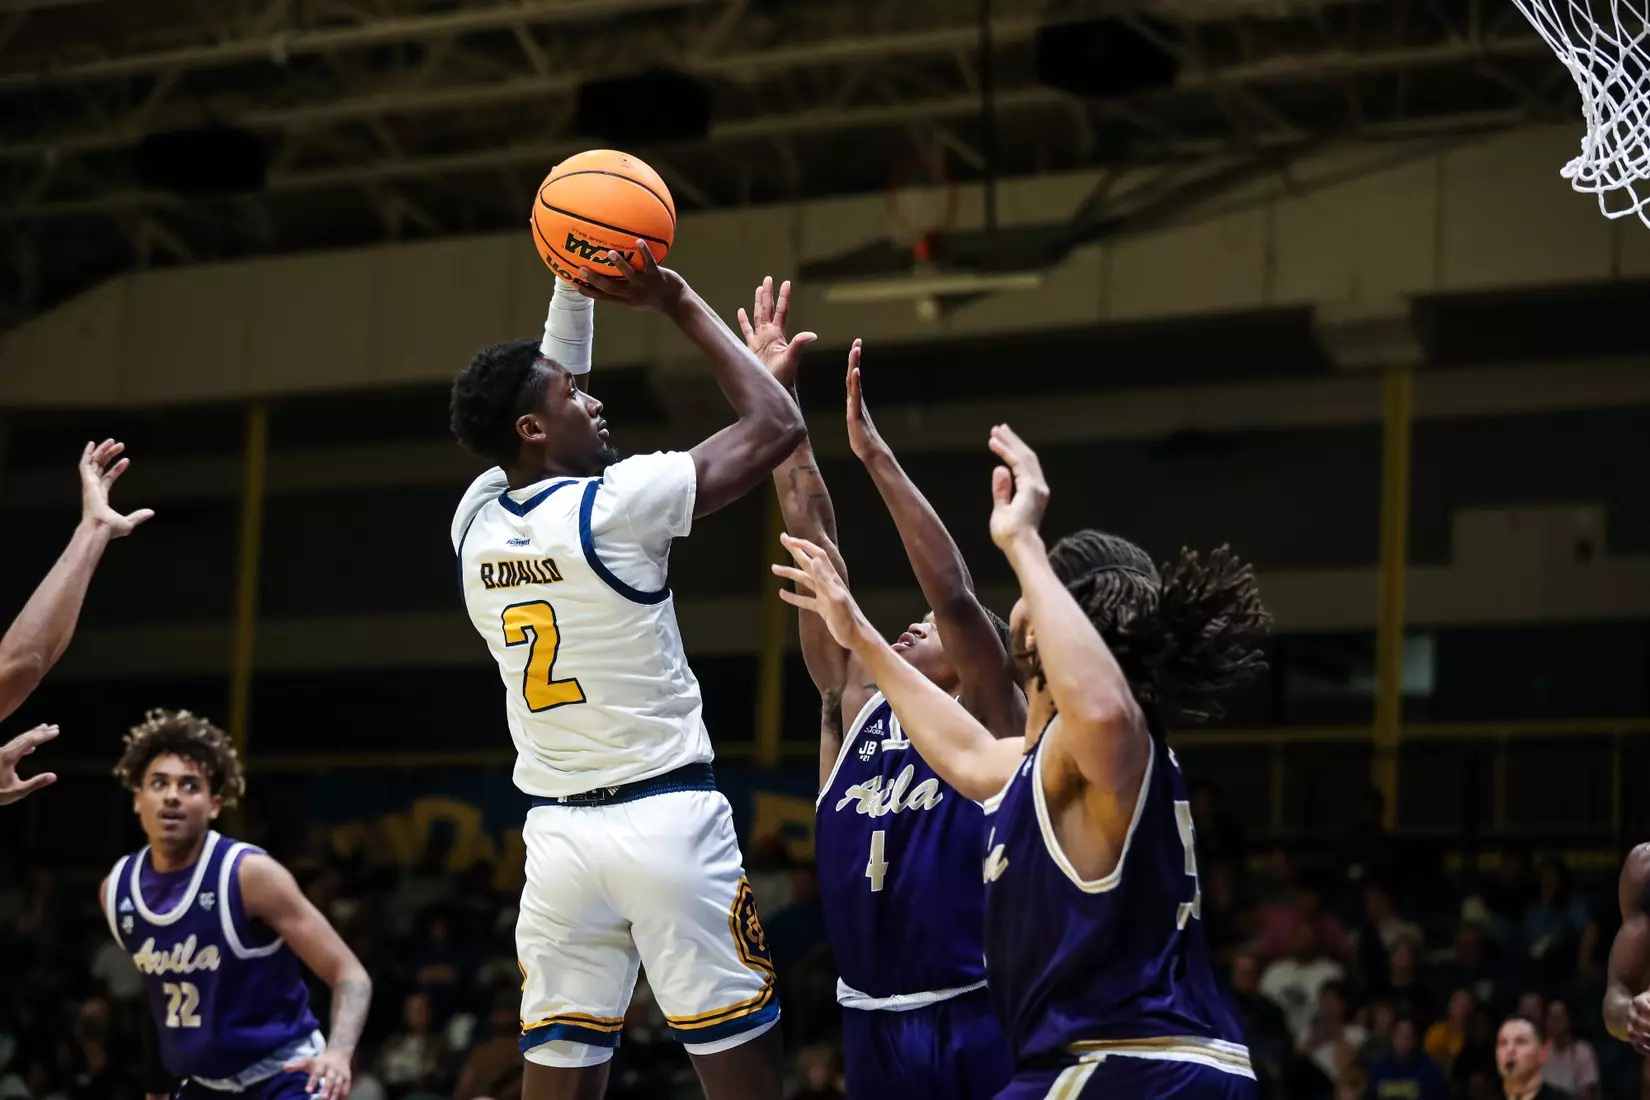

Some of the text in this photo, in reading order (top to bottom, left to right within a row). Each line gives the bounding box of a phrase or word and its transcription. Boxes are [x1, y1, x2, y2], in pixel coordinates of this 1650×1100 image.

[480, 557, 564, 590] B.DIALLO
[501, 599, 587, 713] 2
[858, 740, 878, 755] JB
[865, 830, 889, 892] 4
[132, 933, 221, 976] Avila
[162, 981, 202, 1028] 22
